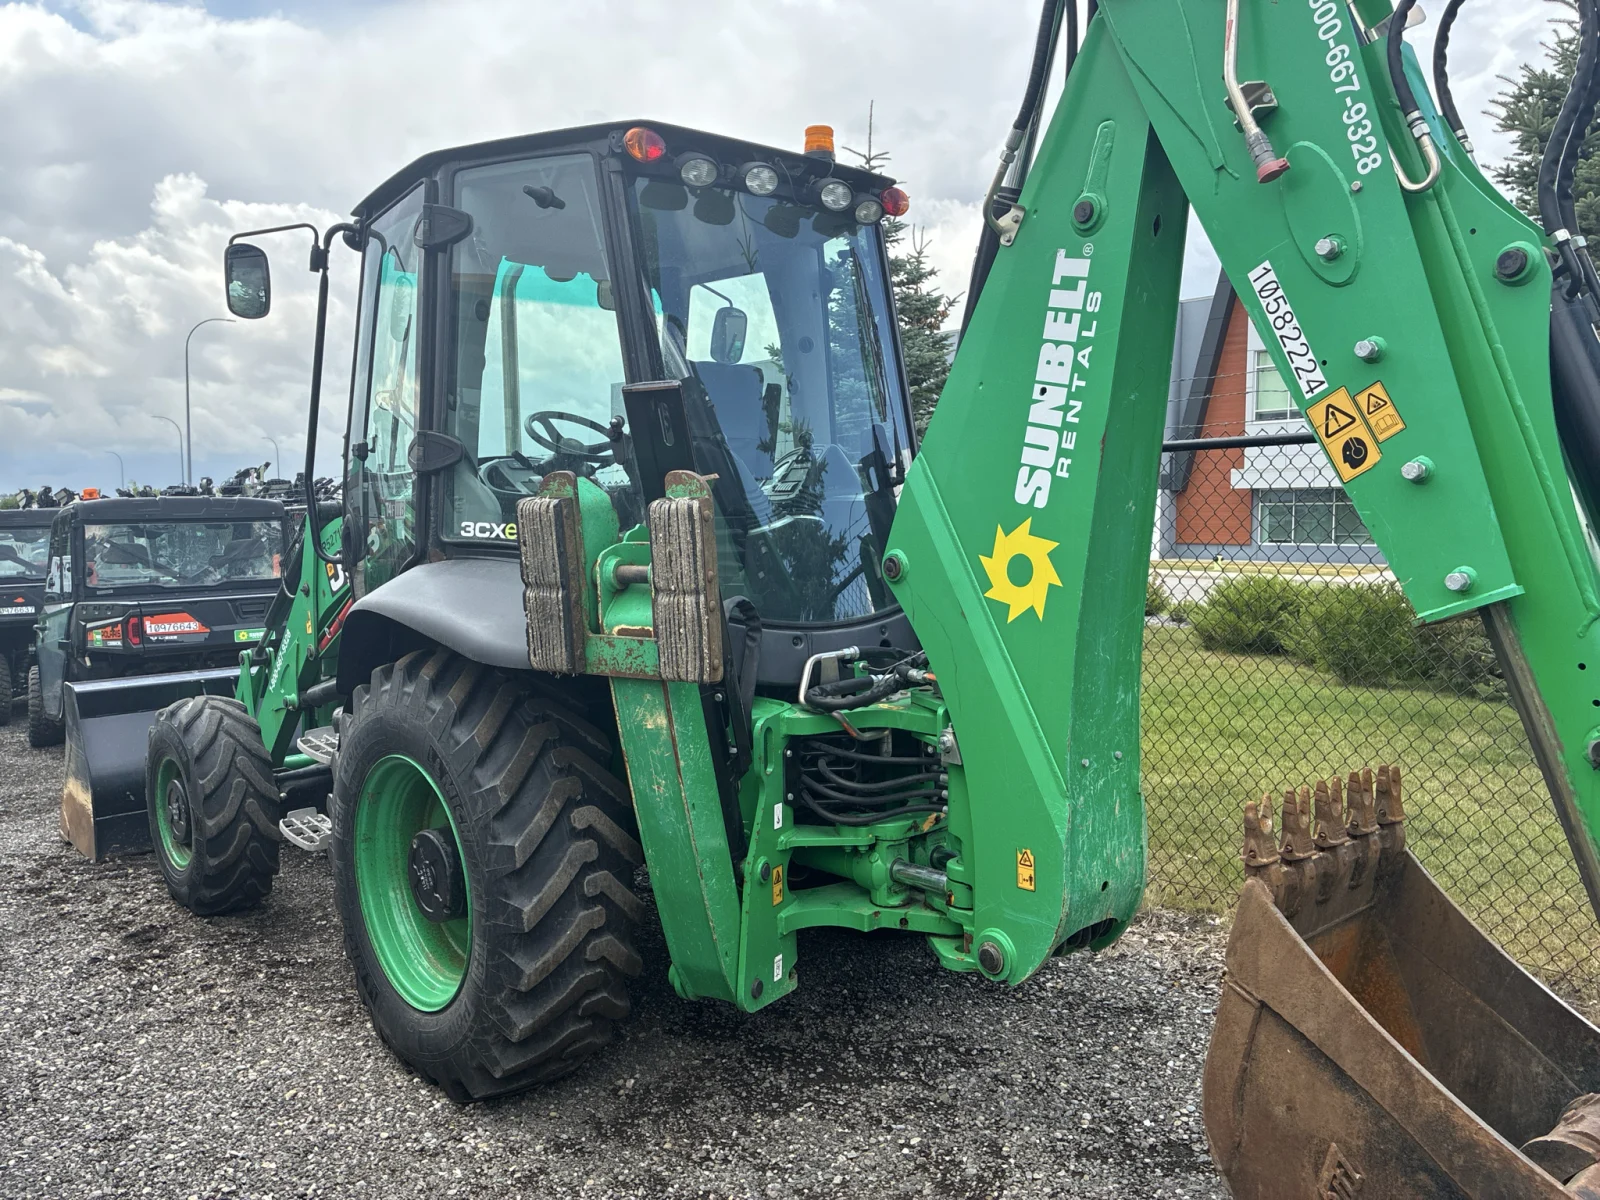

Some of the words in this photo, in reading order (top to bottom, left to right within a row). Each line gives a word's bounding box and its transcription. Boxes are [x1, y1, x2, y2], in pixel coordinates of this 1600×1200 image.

[1014, 248, 1091, 508] SUNBELT
[1055, 291, 1102, 478] RENTALS
[1251, 266, 1325, 396] 10582224
[149, 622, 198, 632] 10976643
